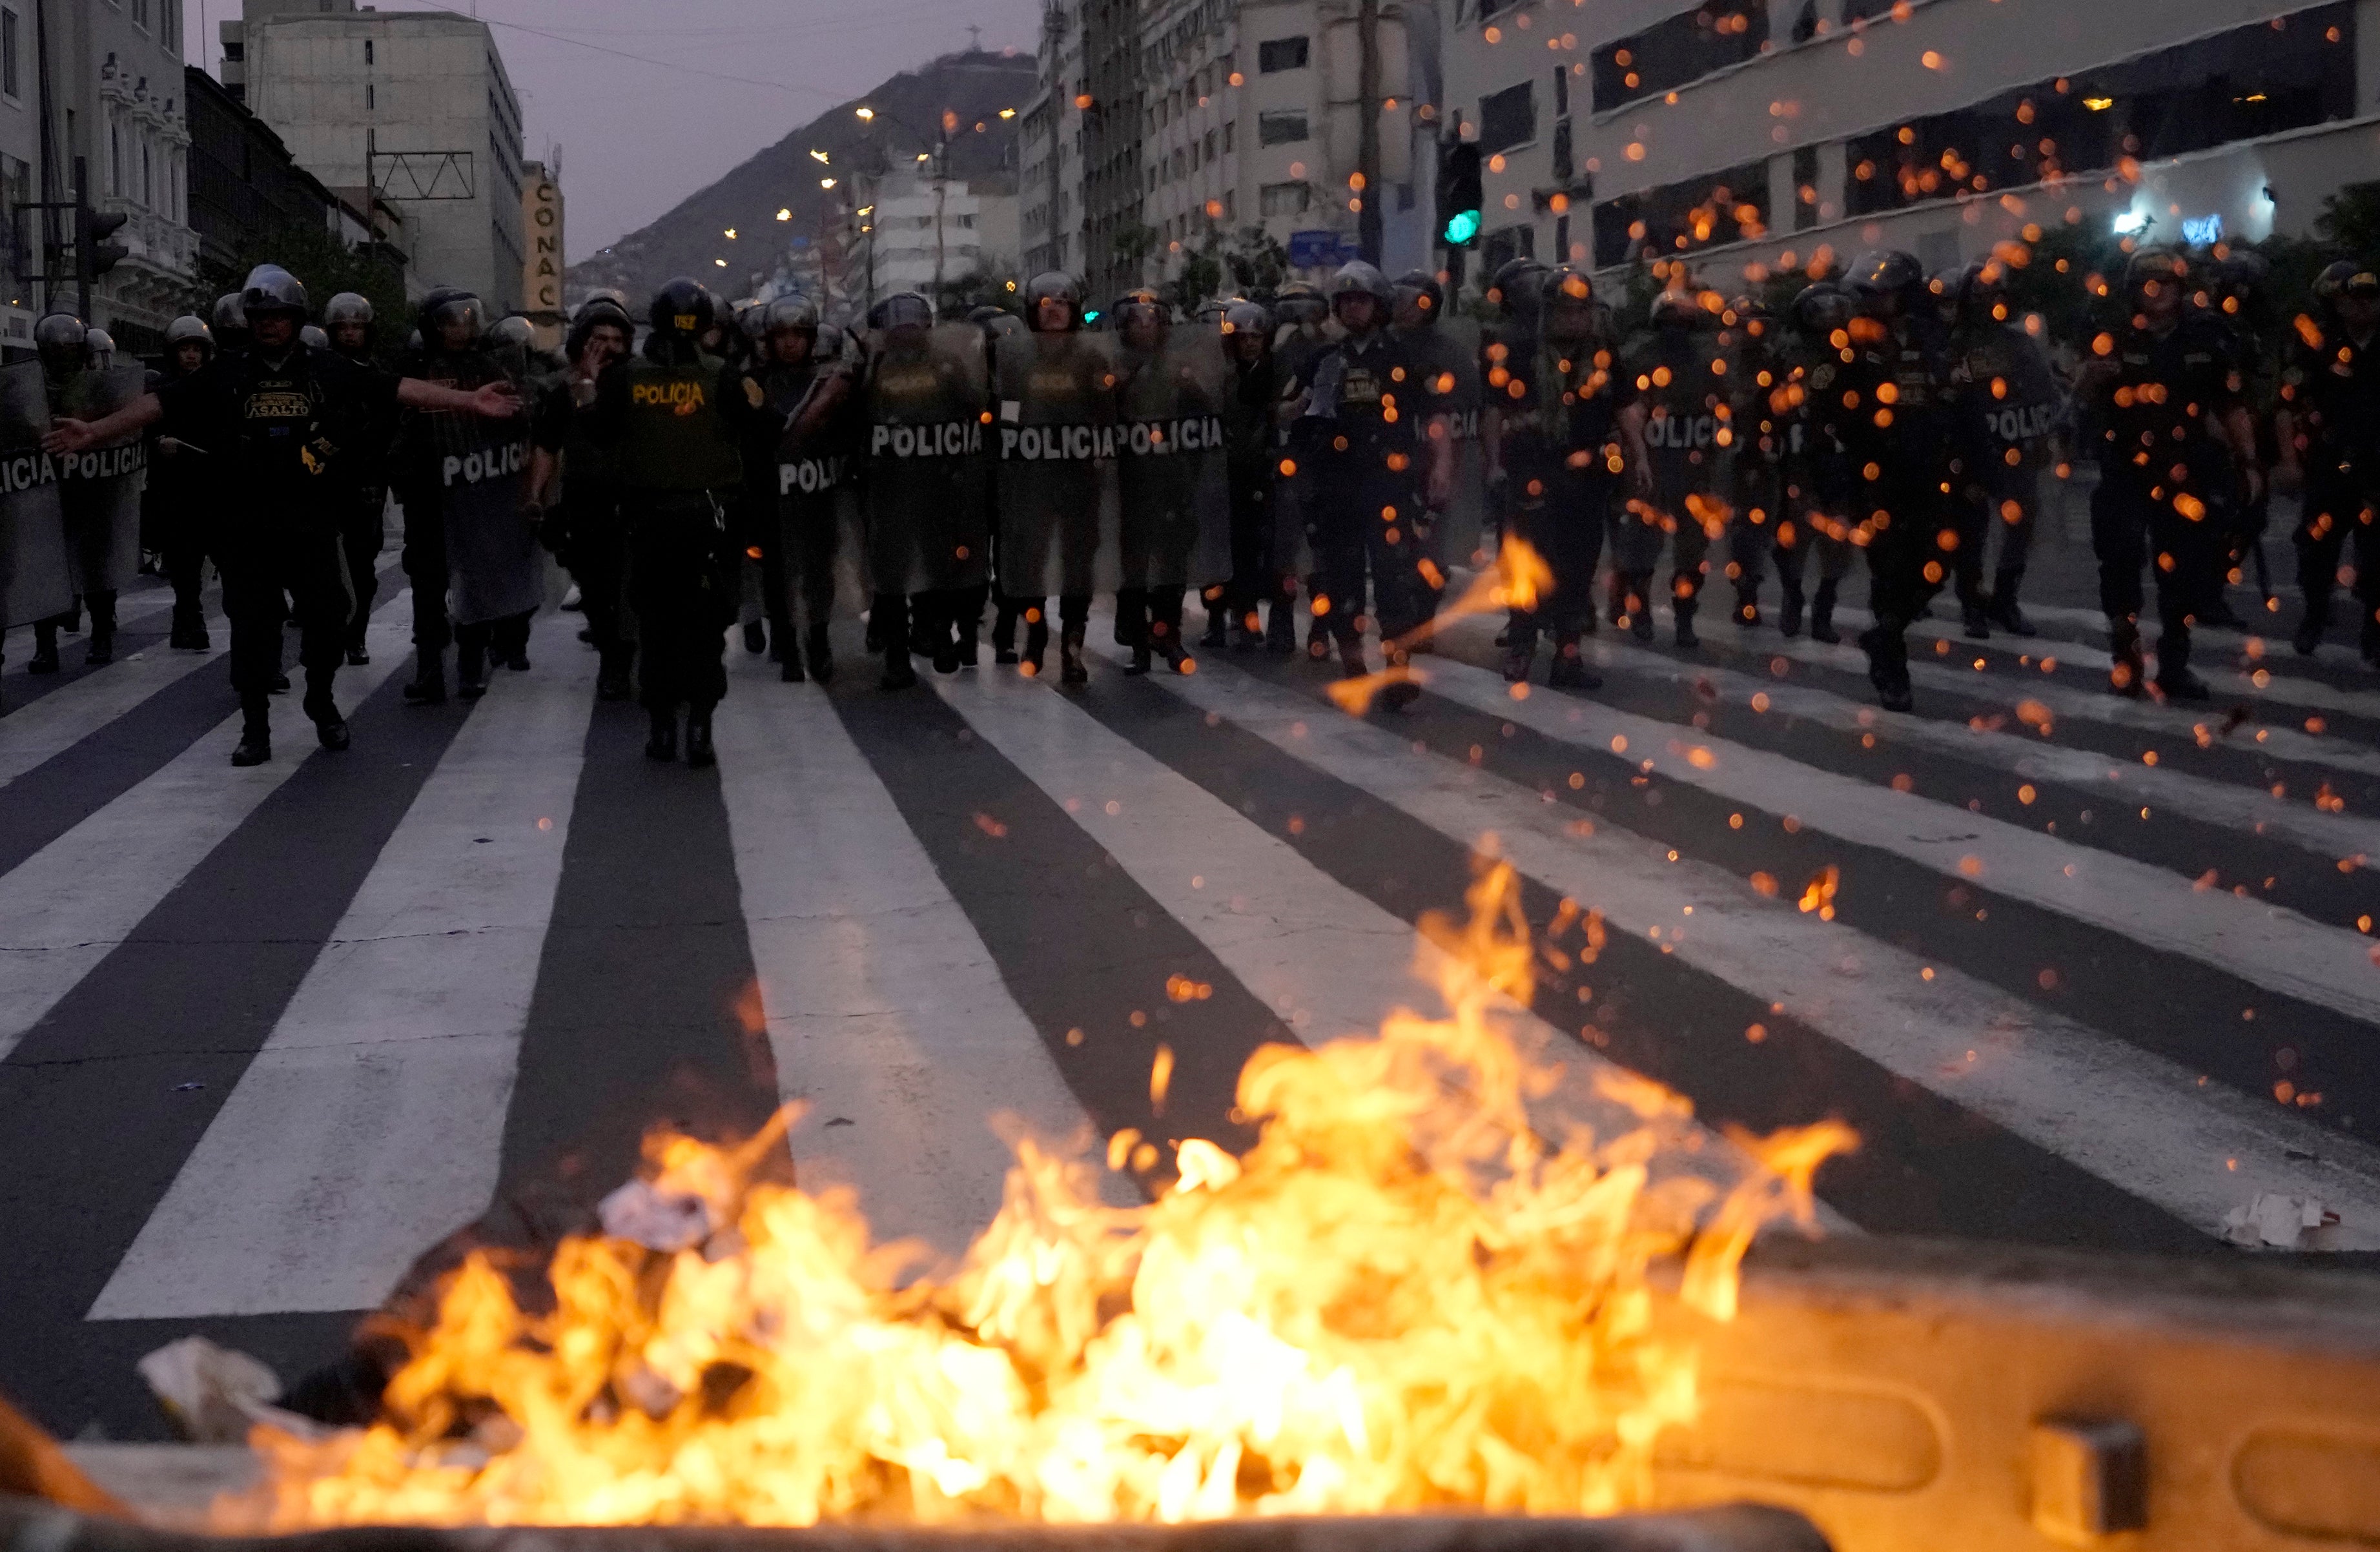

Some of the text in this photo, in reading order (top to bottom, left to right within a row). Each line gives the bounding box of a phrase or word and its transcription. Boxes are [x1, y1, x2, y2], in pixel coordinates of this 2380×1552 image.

[535, 183, 557, 305] CONAC
[249, 405, 309, 418] ASALTO
[633, 382, 705, 405] POLICIA
[872, 420, 982, 457] POLICIA
[1001, 425, 1115, 460] POLICIA
[1115, 416, 1222, 455] POLICIA
